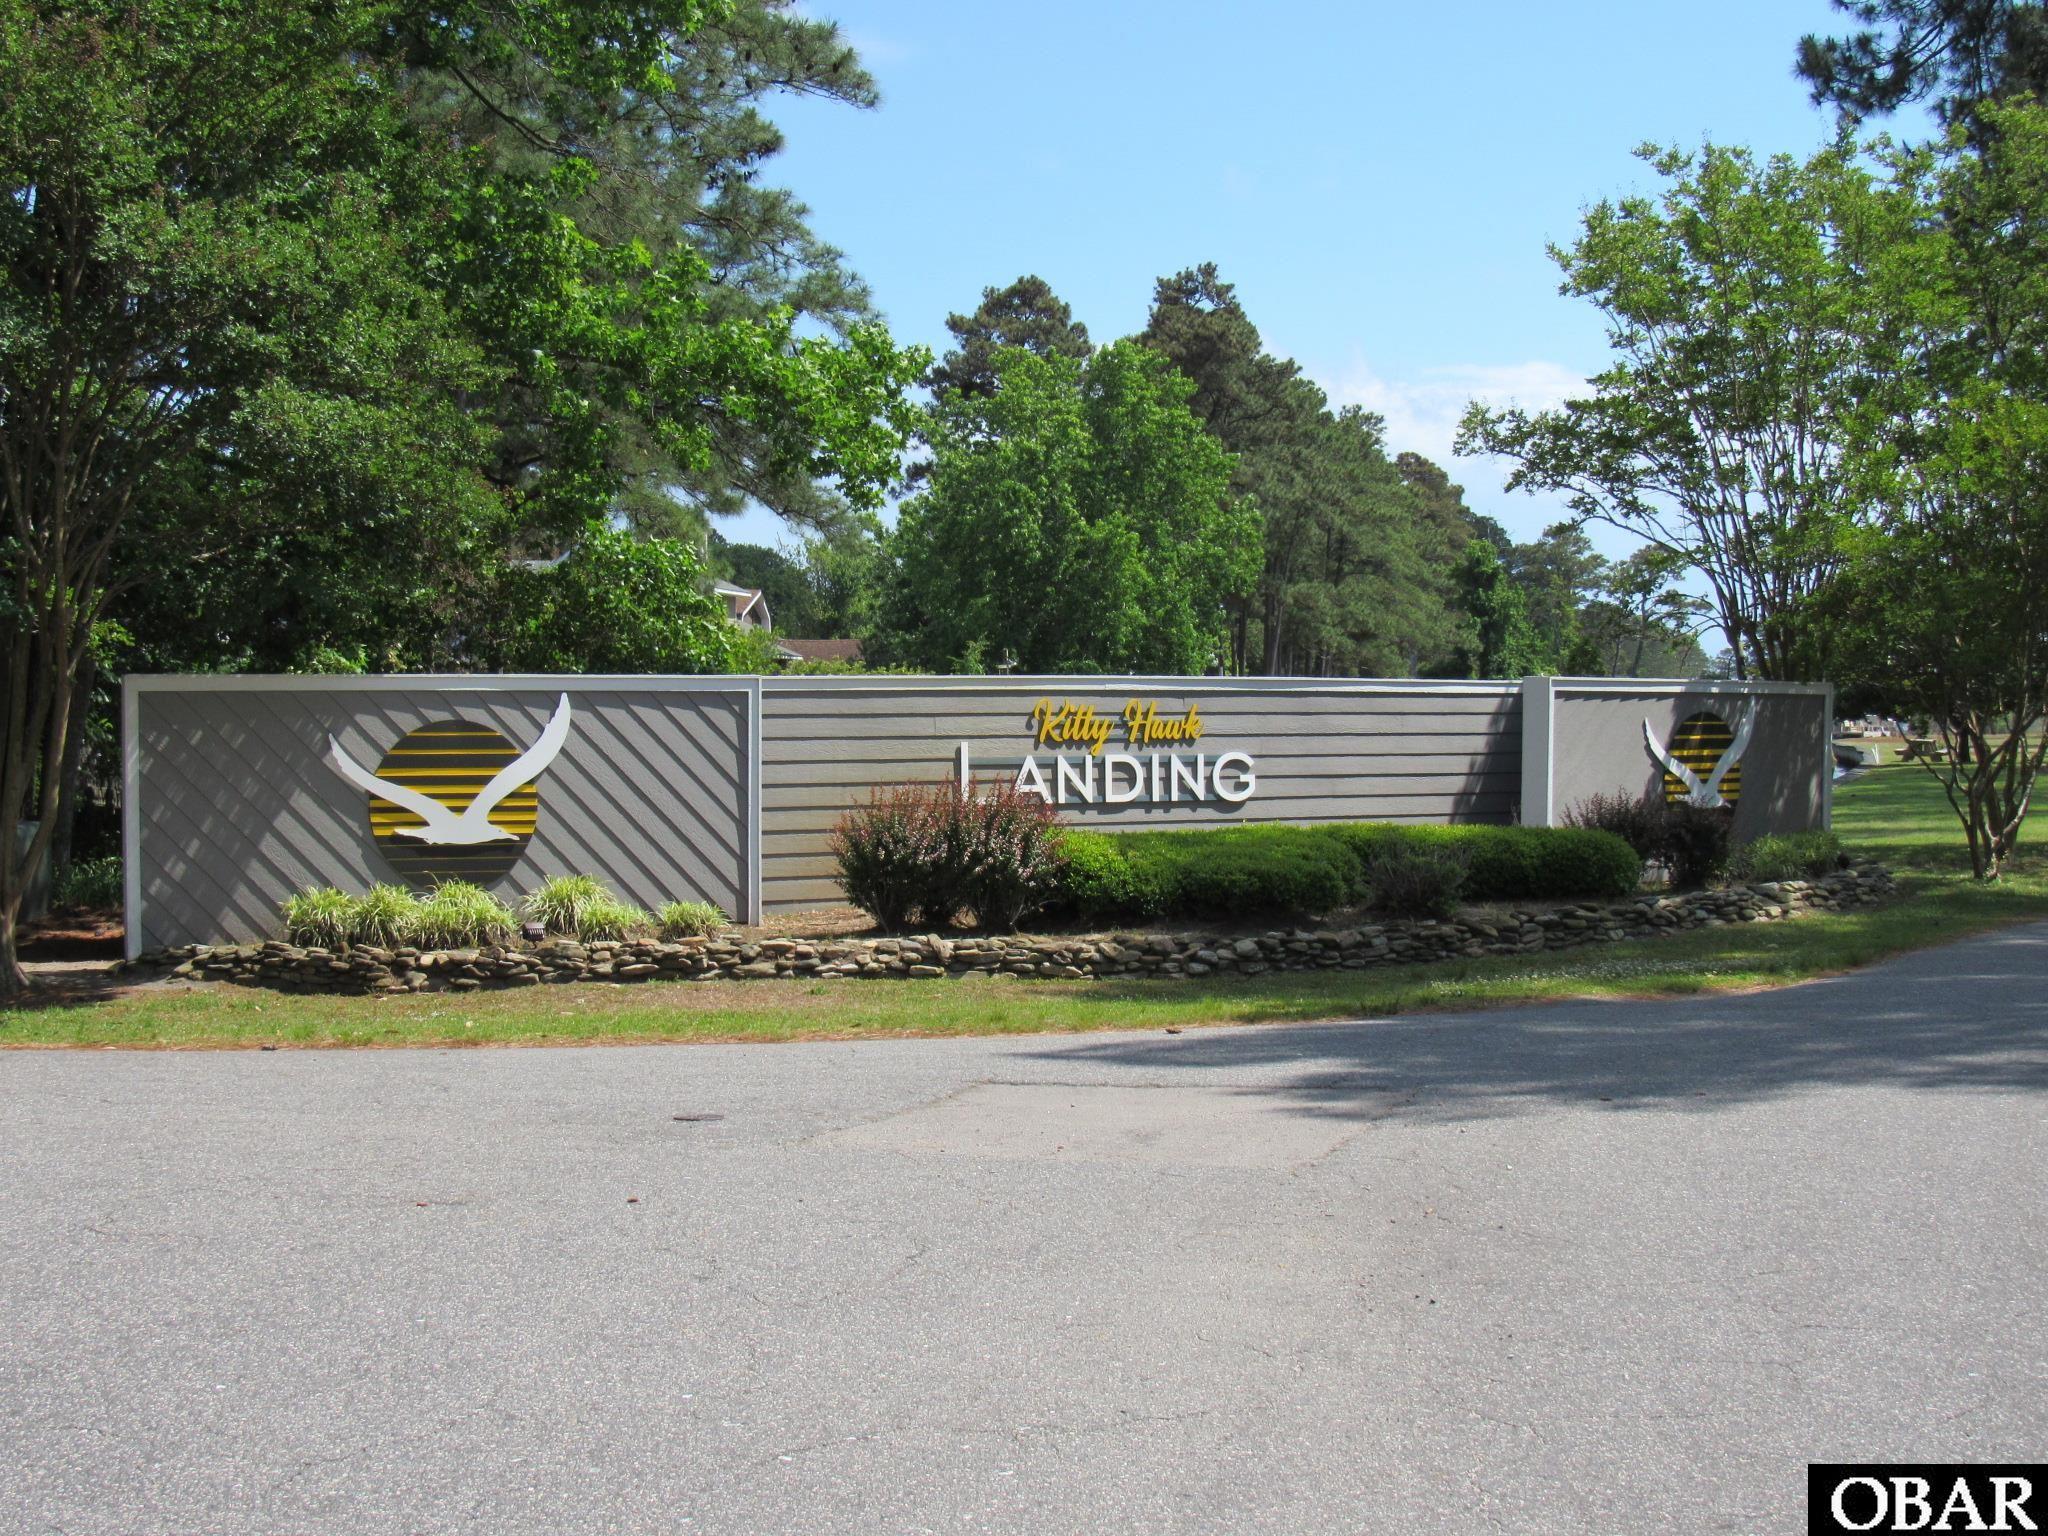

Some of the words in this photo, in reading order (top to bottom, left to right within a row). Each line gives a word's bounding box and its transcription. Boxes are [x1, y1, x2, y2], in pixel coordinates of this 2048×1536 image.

[1033, 698, 1115, 756] Kitty
[1124, 699, 1204, 743] Hawk
[960, 741, 1256, 804] LANDING
